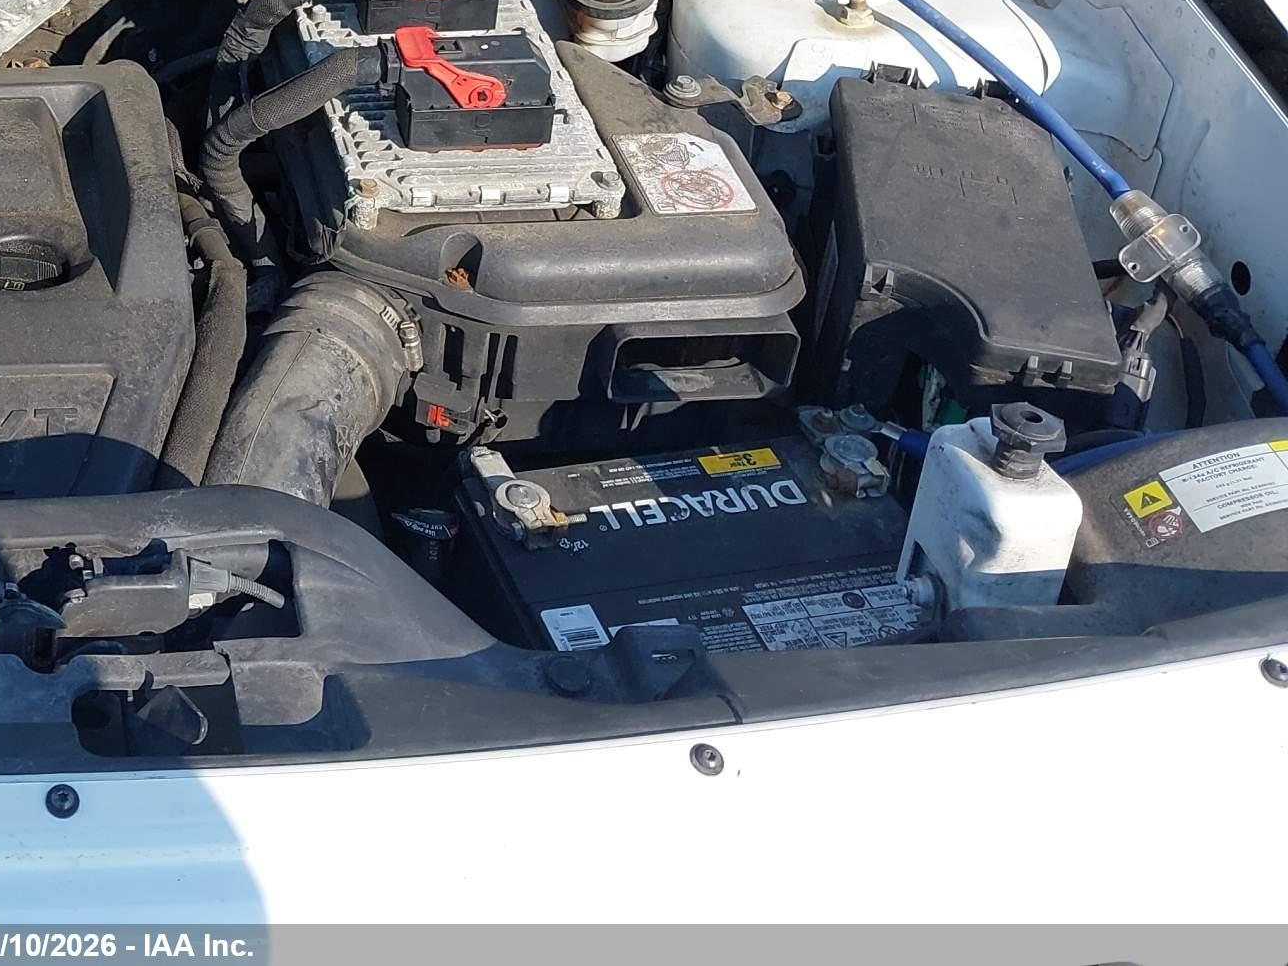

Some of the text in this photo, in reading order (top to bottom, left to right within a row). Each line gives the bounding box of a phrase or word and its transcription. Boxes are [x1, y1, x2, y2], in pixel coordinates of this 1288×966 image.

[742, 451, 757, 466] 3
[1192, 452, 1240, 470] ATTENTION
[589, 478, 808, 531] DURACELL
